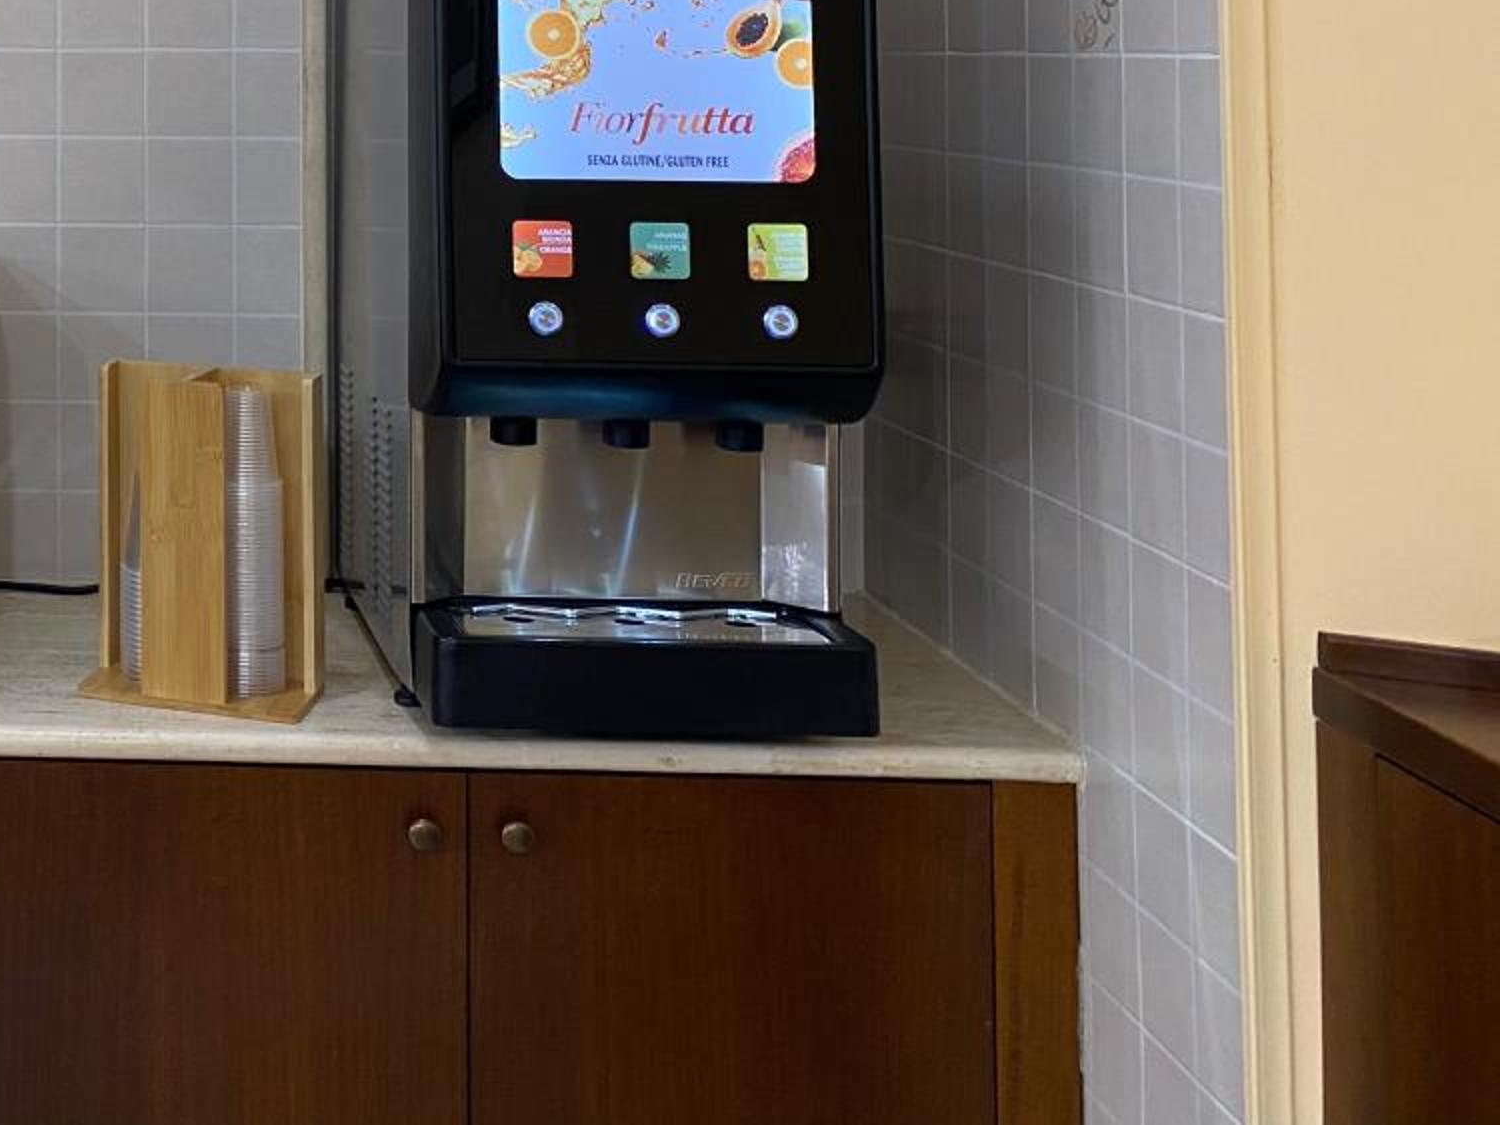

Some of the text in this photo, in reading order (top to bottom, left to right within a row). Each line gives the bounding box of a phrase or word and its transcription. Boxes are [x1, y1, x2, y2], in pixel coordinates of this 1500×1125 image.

[570, 101, 755, 146] Fiorfrutta
[587, 154, 619, 166] SENZA
[705, 156, 730, 168] FREE
